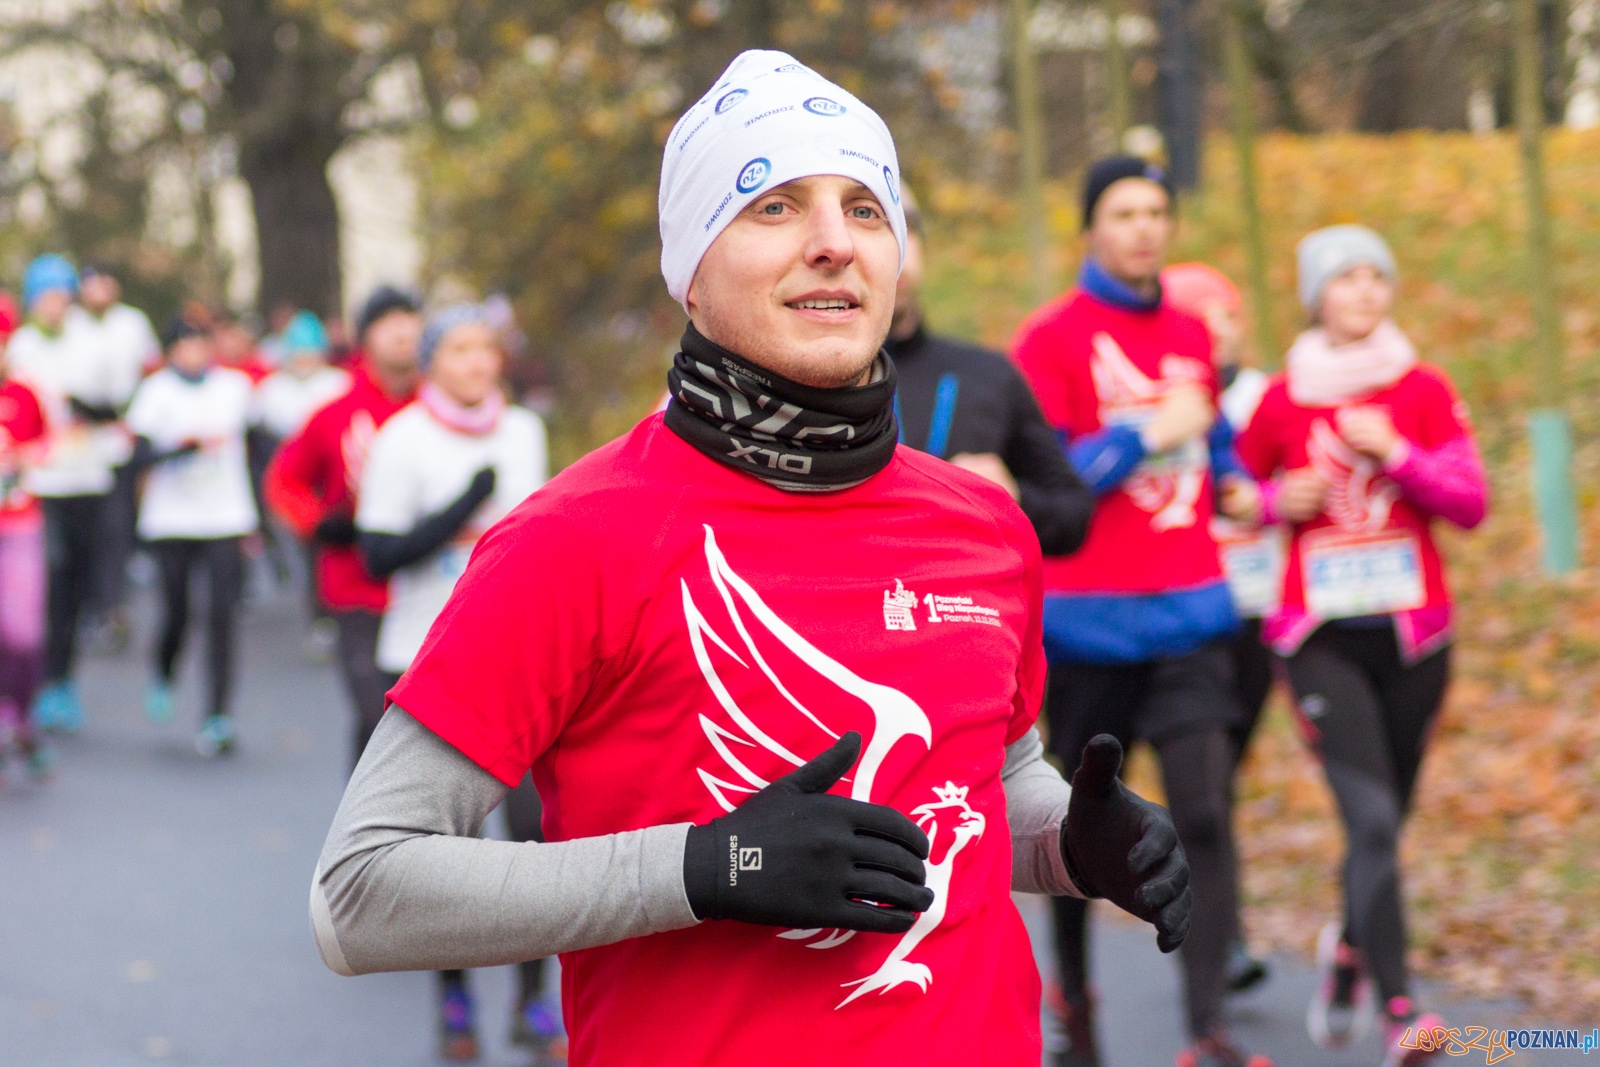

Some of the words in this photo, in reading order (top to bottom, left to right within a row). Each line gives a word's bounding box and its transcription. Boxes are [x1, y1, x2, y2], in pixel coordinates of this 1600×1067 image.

[744, 105, 795, 128] ZDROWIE
[838, 149, 879, 169] ZDROWIE
[704, 192, 733, 232] ZDROWIE
[721, 356, 773, 388] TRESPASS
[727, 438, 812, 475] DLX
[923, 592, 942, 623] 1
[730, 835, 738, 886] salomon
